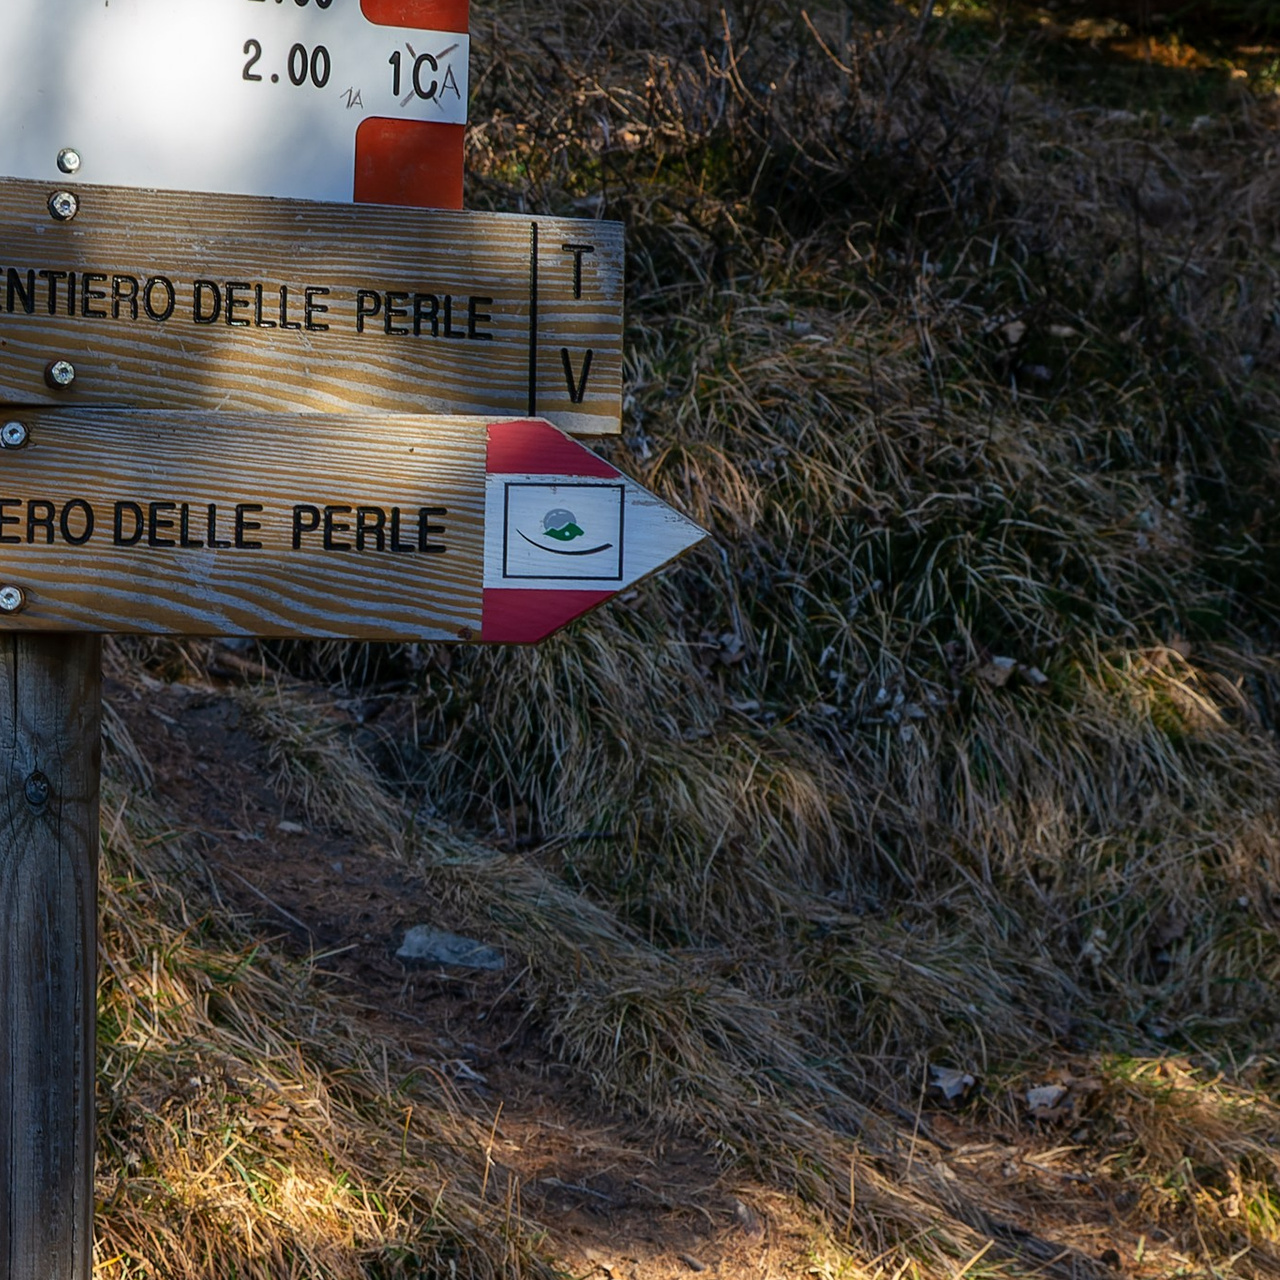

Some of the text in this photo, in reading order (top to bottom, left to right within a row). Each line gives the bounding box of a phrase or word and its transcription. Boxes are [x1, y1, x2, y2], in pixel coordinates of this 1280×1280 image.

[242, 38, 331, 89] 2.00
[561, 243, 595, 300] T
[192, 280, 330, 332] DELLE
[356, 289, 494, 341] PERLE
[560, 346, 594, 404] V
[113, 500, 264, 550] DELLE
[292, 504, 448, 554] PERLE
